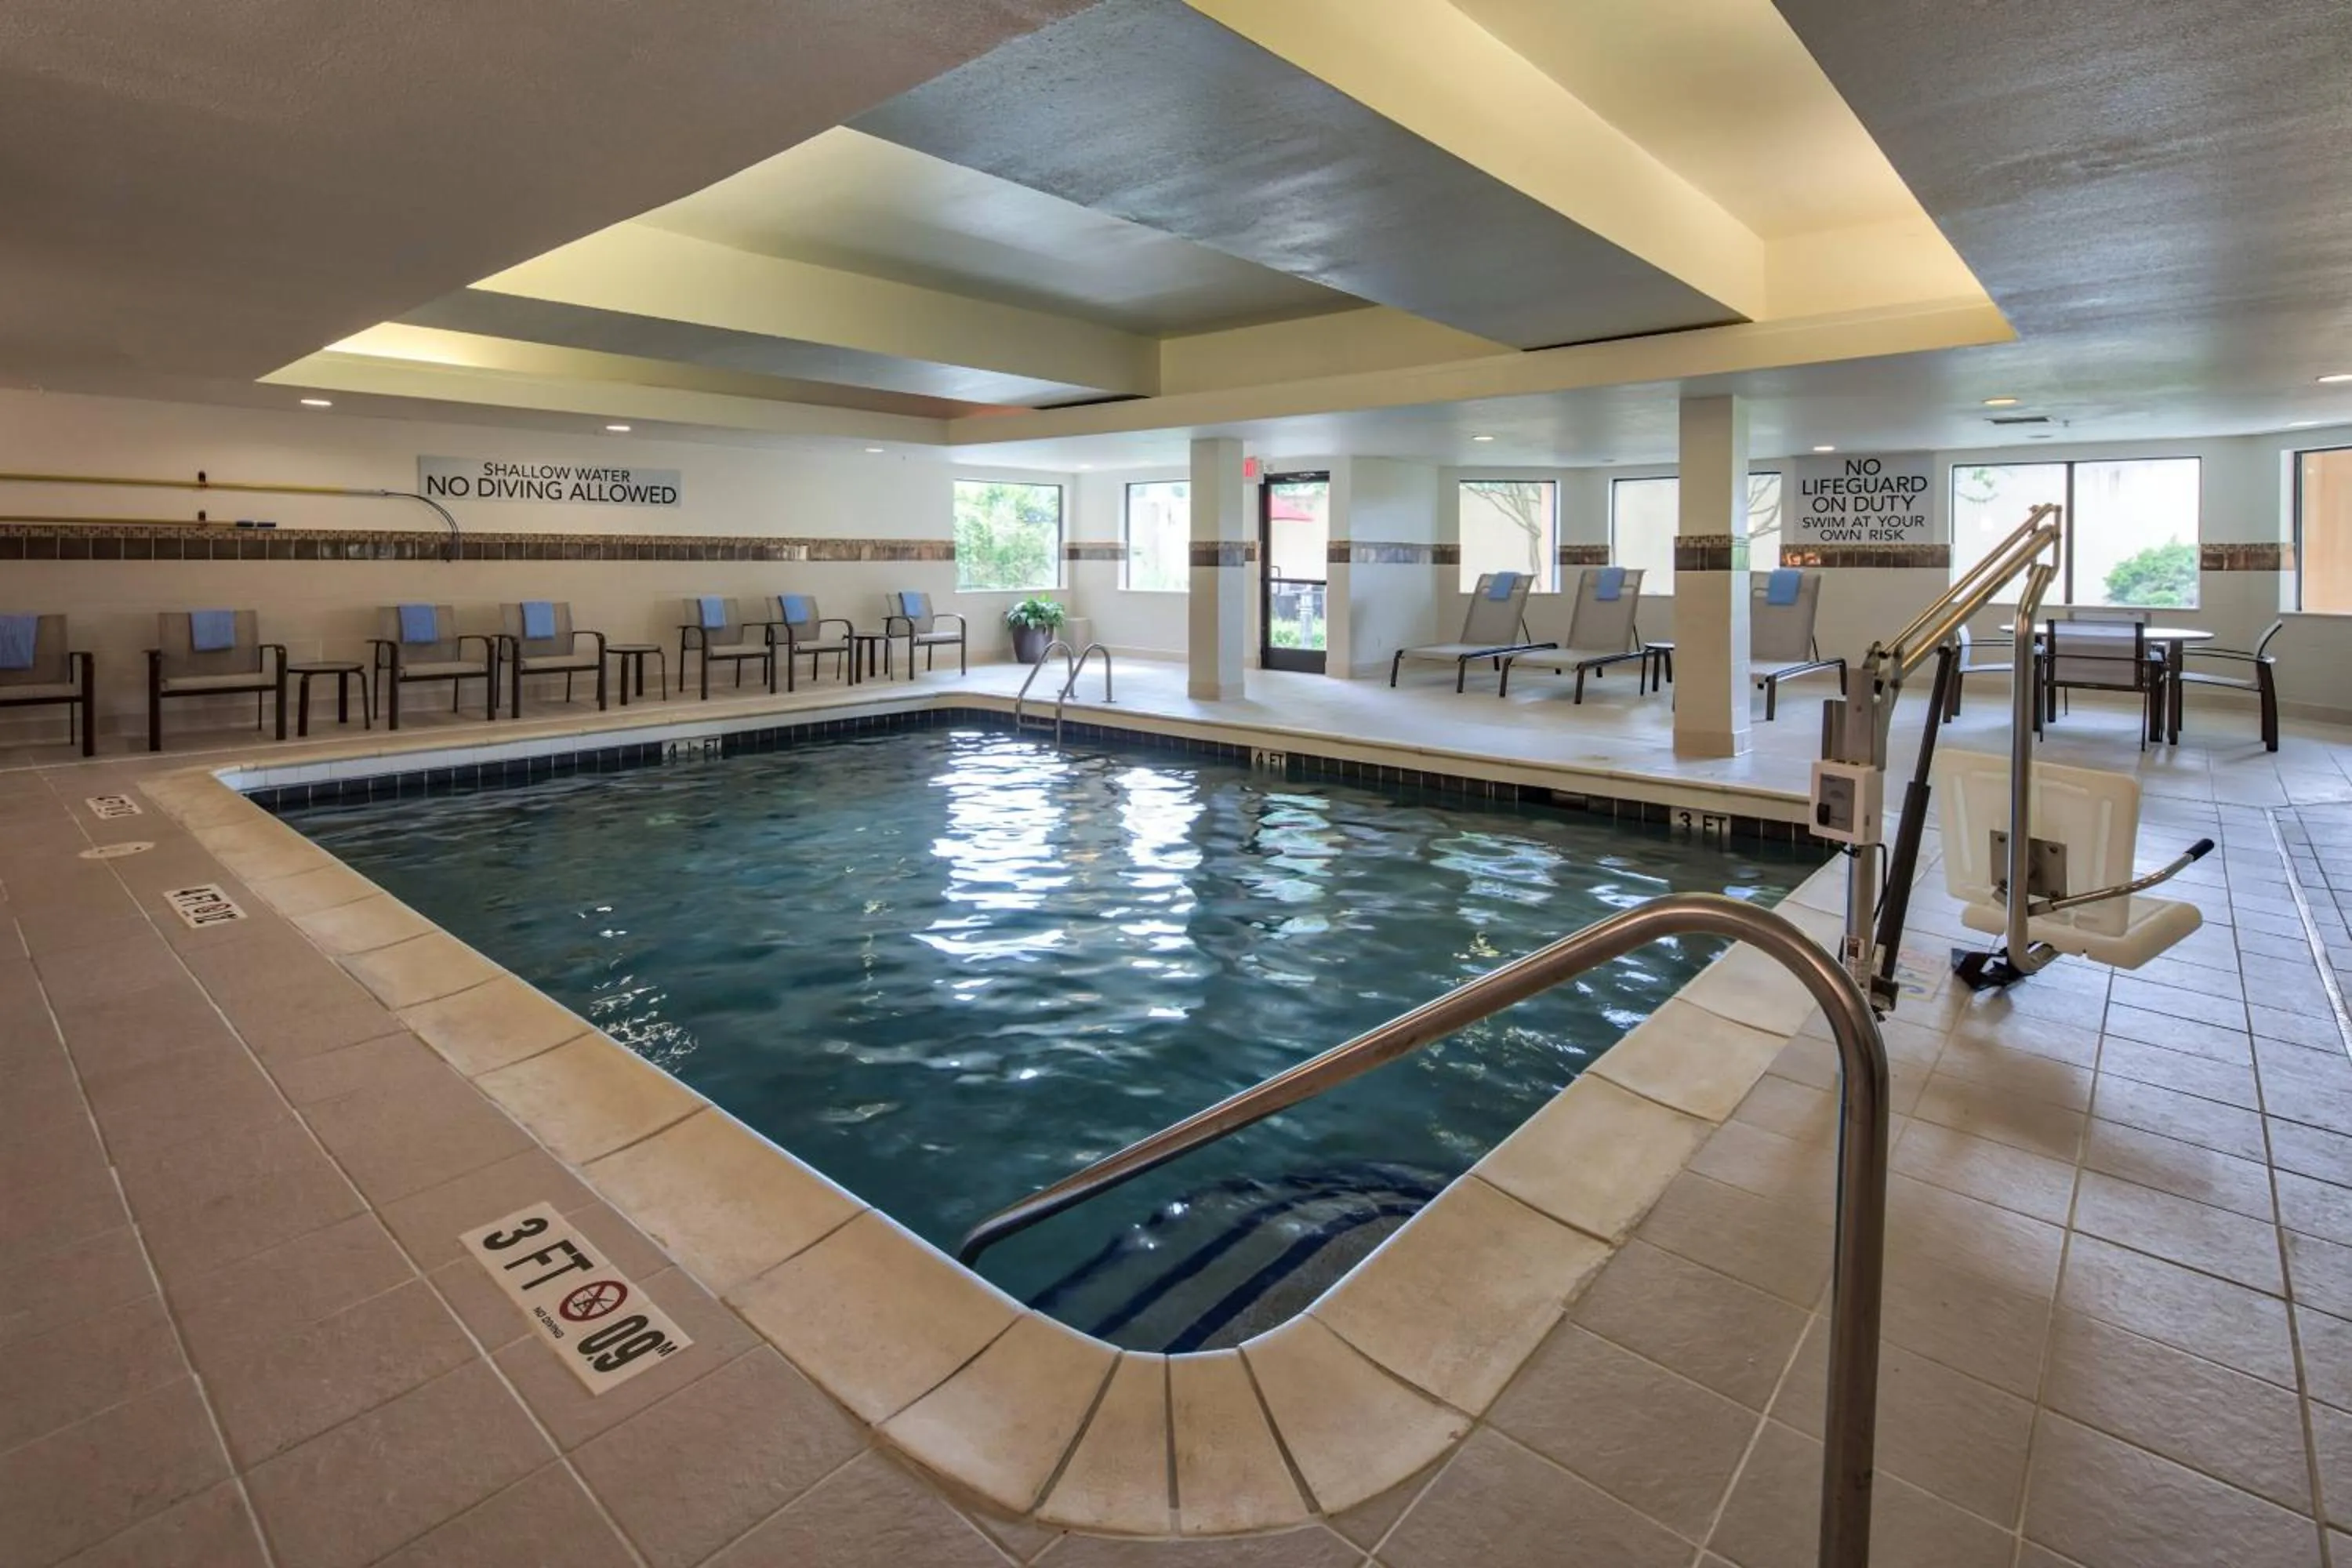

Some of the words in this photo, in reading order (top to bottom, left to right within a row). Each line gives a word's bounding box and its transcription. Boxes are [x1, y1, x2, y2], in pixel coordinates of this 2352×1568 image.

[483, 461, 570, 481] SHALLOW
[575, 467, 630, 484] WATER
[1845, 458, 1882, 476] NO
[426, 475, 470, 497] NO
[477, 477, 562, 501] DIVING
[569, 483, 677, 505] ALLOWED
[1802, 475, 1928, 495] LIFEGUARD
[1812, 495, 1846, 514] ON
[1853, 495, 1916, 513] DUTY
[1802, 516, 1846, 528] SWIM
[1851, 515, 1871, 528] AT
[1877, 514, 1926, 528] YOUR
[1820, 528, 1862, 542] OWN
[1868, 528, 1905, 541] RISK
[1702, 815, 1727, 833] FT
[481, 1217, 549, 1250] 3
[503, 1239, 595, 1291] FT
[533, 1305, 546, 1318] NO
[542, 1316, 565, 1339] DIVING
